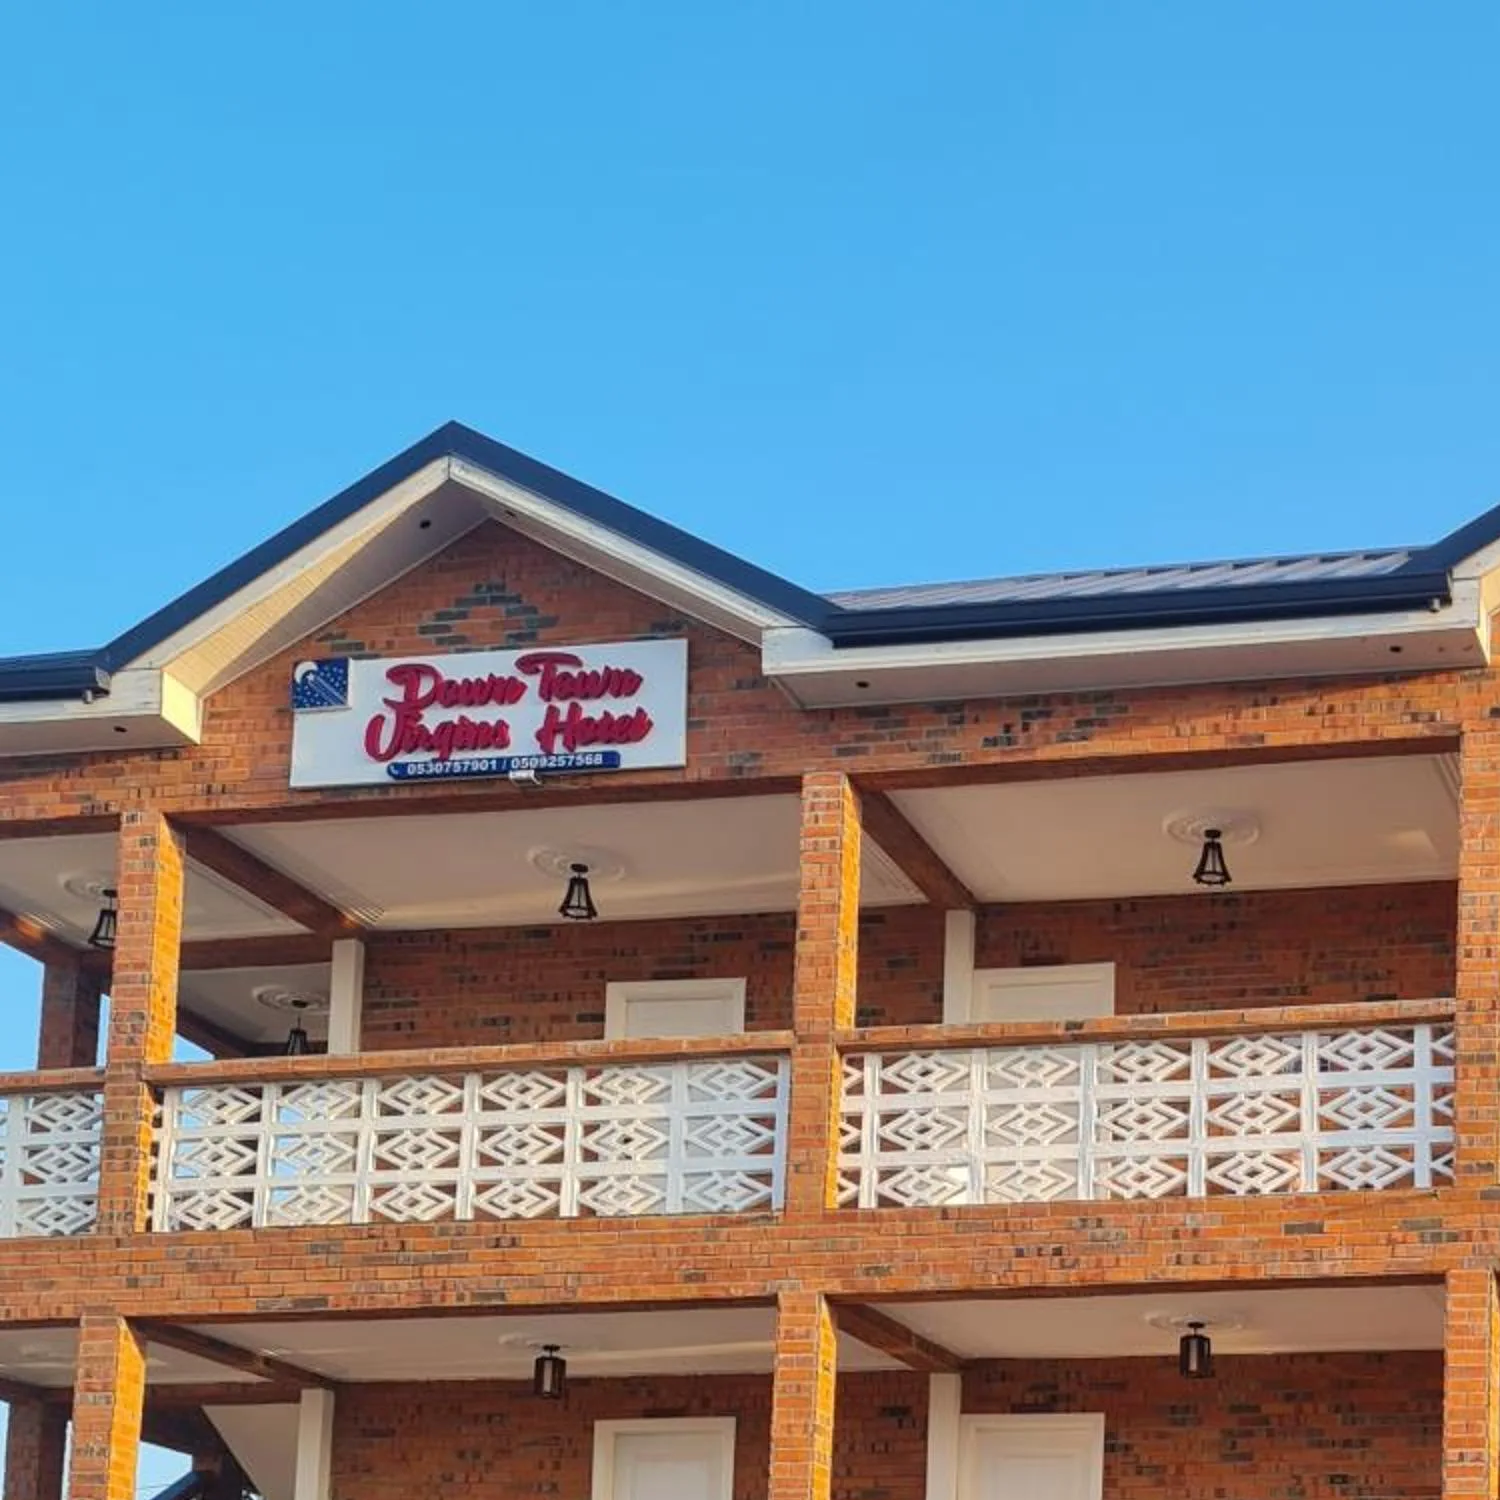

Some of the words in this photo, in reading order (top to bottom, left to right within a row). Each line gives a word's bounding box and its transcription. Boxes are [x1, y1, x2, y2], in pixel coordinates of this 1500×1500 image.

[383, 662, 528, 710] Down
[515, 651, 644, 702] Town
[535, 702, 655, 754] Hotel
[407, 759, 498, 776] 0530757901
